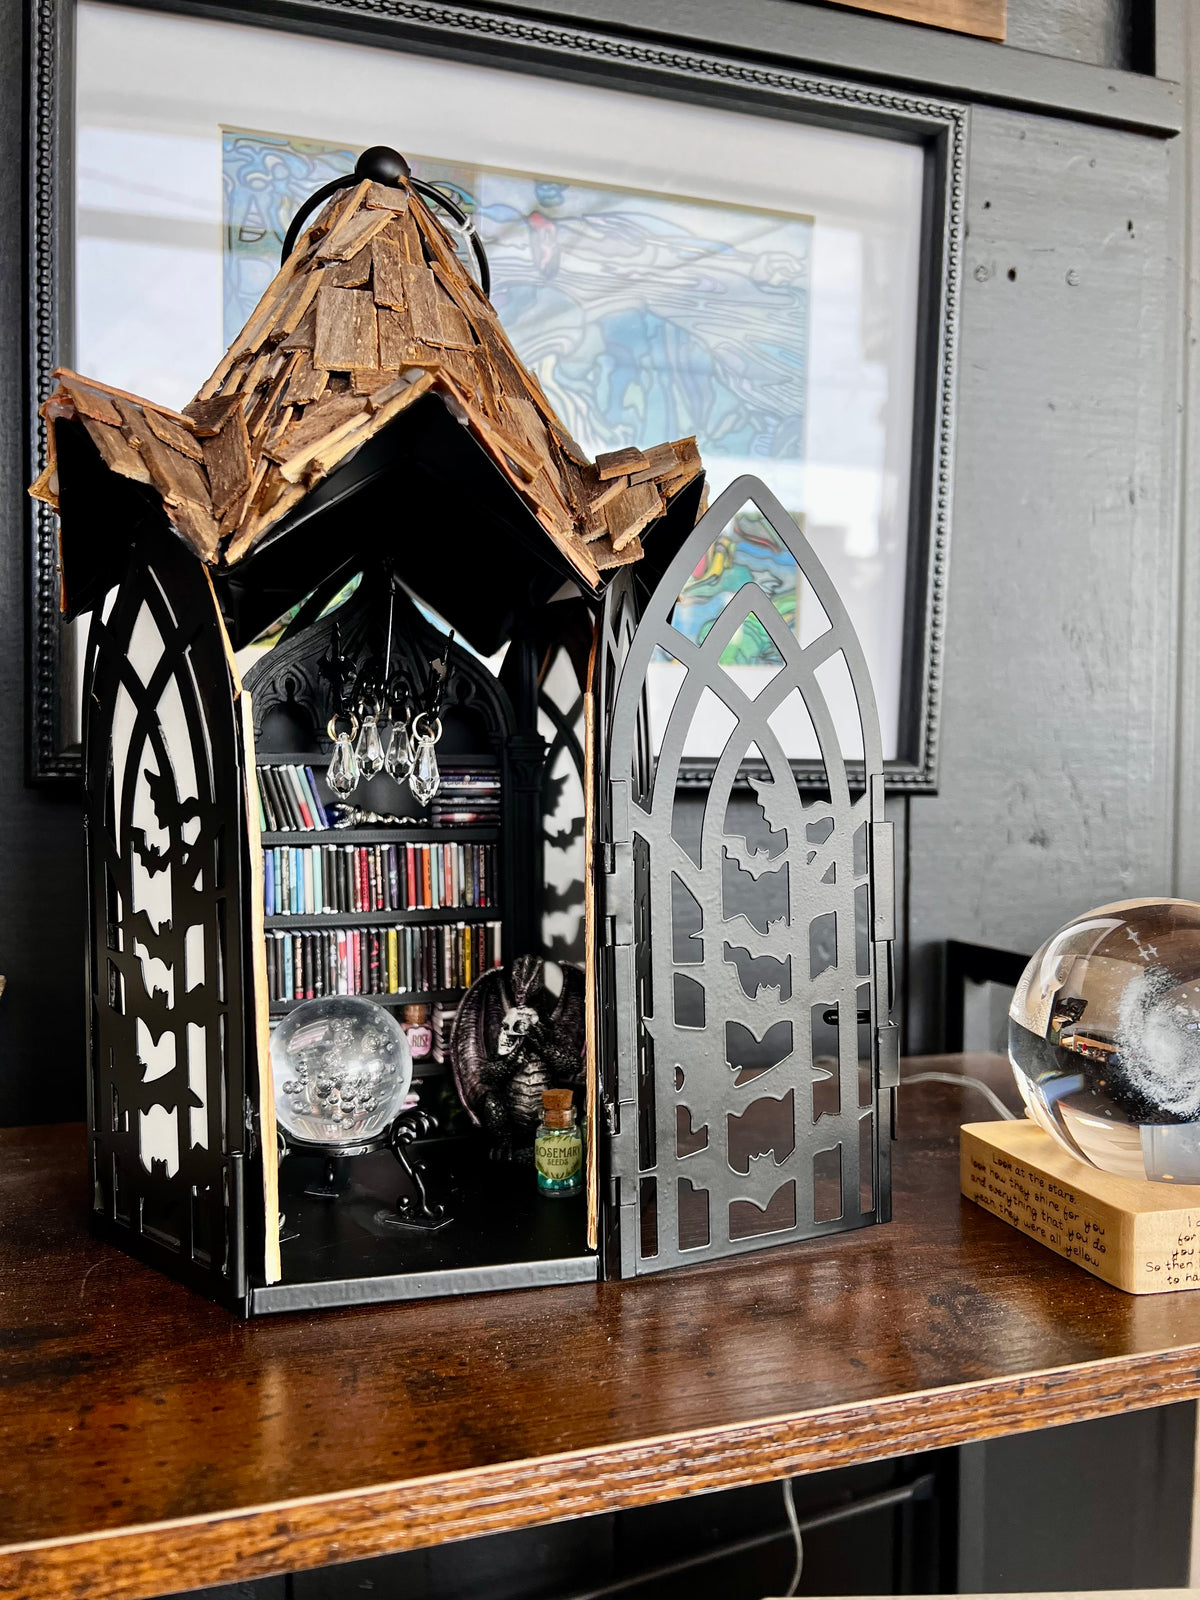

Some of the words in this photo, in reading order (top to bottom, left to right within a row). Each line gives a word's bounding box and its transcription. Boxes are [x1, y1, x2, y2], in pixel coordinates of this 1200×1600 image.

[547, 1158, 569, 1166] SEEDS
[1014, 1167, 1025, 1178] at
[1028, 1172, 1045, 1188] the
[989, 1165, 1006, 1184] how
[1009, 1176, 1030, 1202] they
[1034, 1192, 1060, 1212] shine
[1063, 1205, 1080, 1221] for
[1084, 1220, 1105, 1236] you
[970, 1174, 986, 1188] and
[988, 1184, 1038, 1222] everything
[1041, 1209, 1064, 1231] that
[1067, 1227, 1088, 1243] you
[1092, 1237, 1107, 1254] do
[999, 1203, 1020, 1227] they
[1023, 1221, 1046, 1237] were
[1049, 1232, 1062, 1246] all
[1066, 1243, 1100, 1268] yellow
[1177, 1231, 1197, 1247] for
[1171, 1248, 1195, 1261] you
[1145, 1261, 1161, 1273] So
[1165, 1259, 1194, 1271] then
[1166, 1275, 1180, 1285] to
